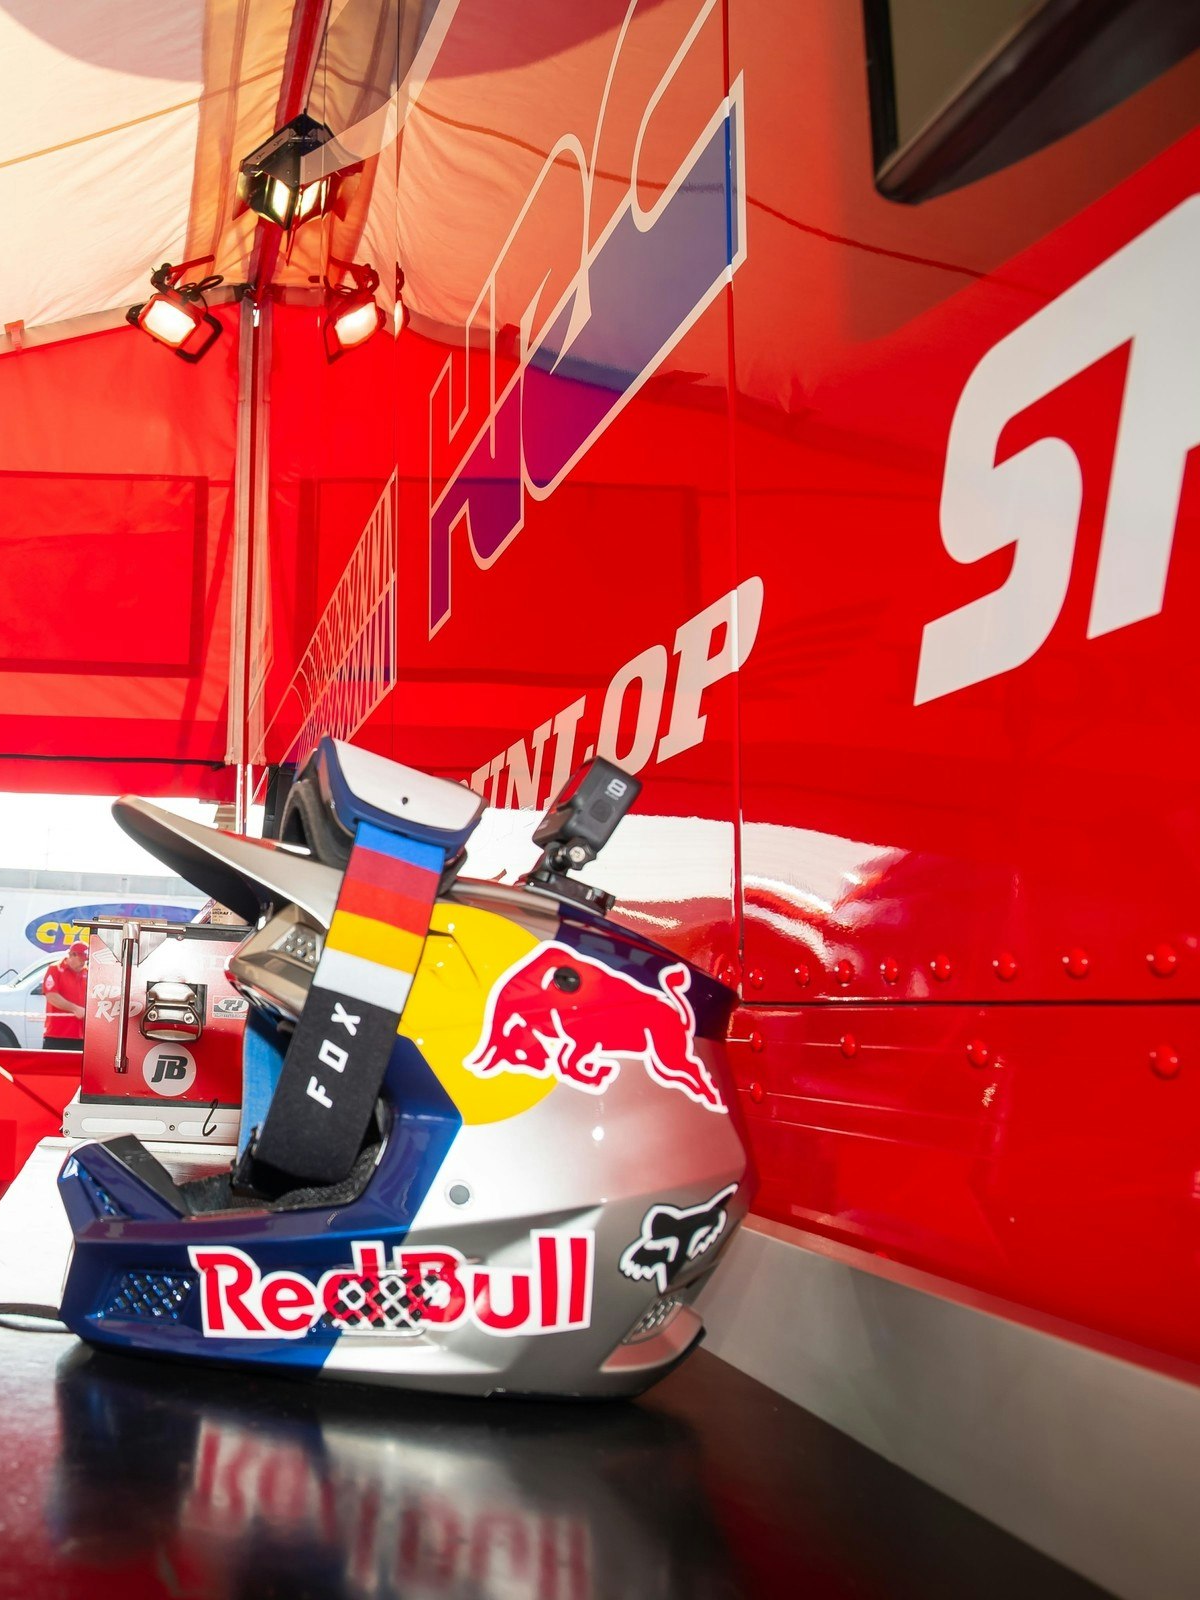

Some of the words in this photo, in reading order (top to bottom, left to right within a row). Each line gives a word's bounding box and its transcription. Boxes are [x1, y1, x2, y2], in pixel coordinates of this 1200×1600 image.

[457, 576, 764, 812] UNLOP
[150, 1054, 189, 1083] JB
[306, 1001, 362, 1110] FOX
[187, 1240, 386, 1339] Red
[392, 1228, 596, 1337] Bull
